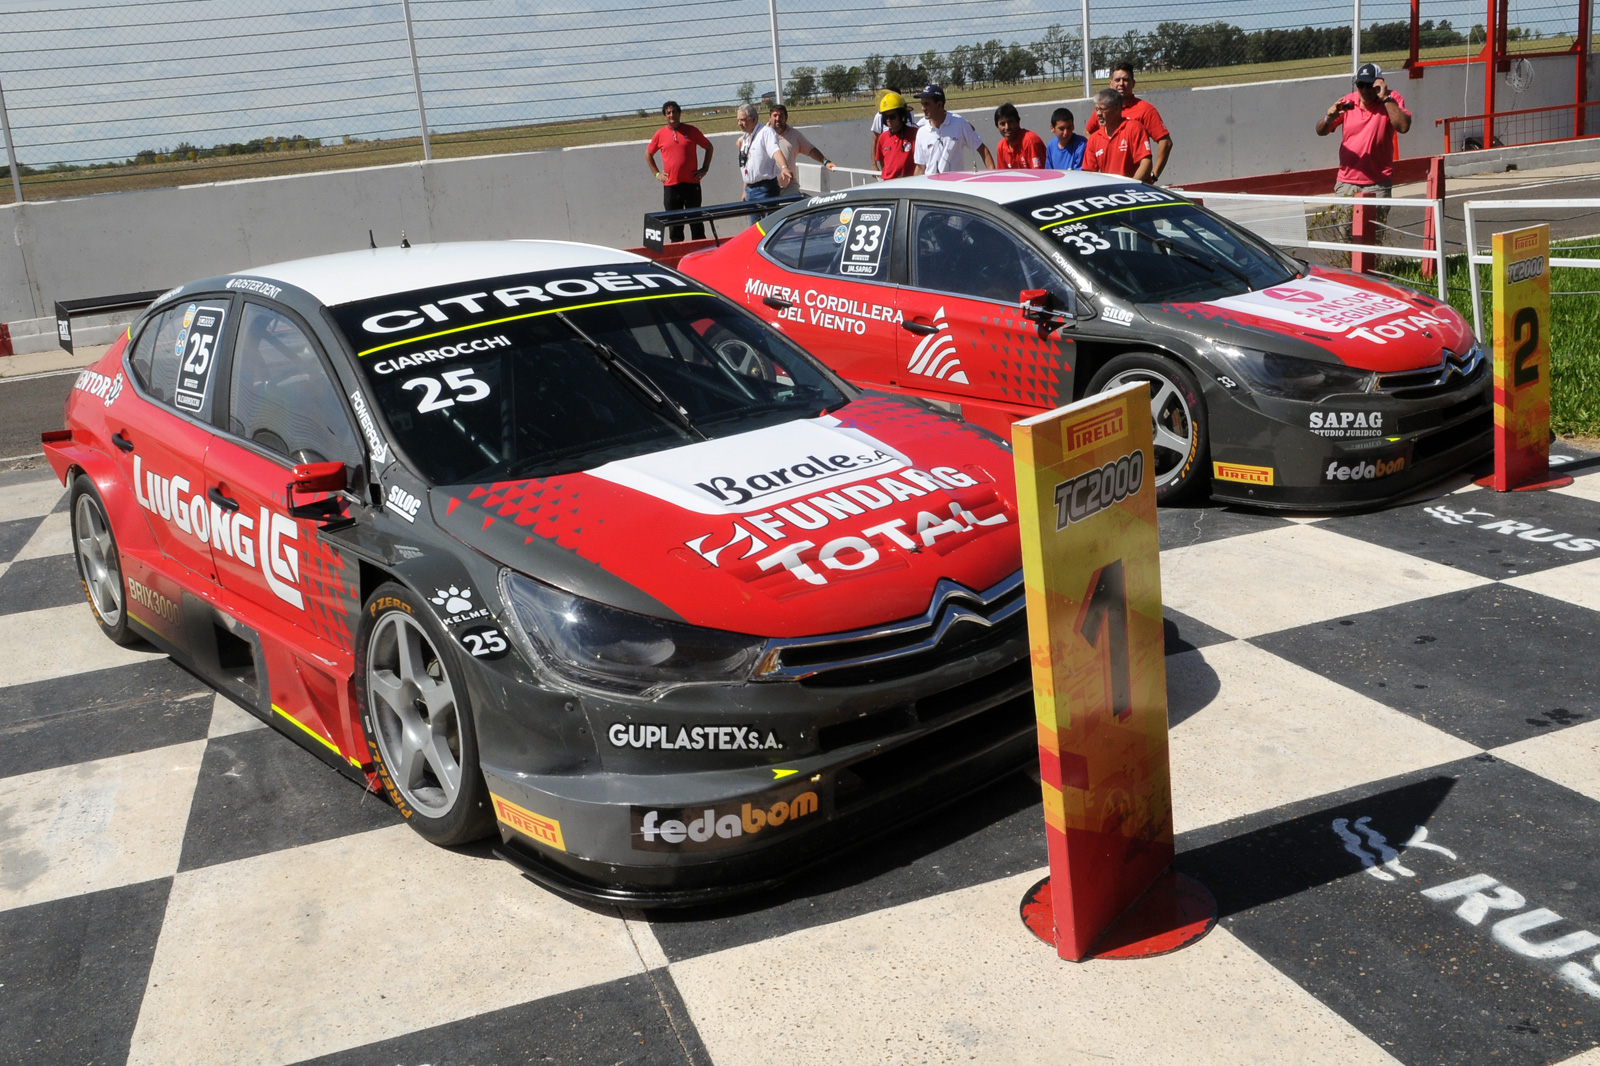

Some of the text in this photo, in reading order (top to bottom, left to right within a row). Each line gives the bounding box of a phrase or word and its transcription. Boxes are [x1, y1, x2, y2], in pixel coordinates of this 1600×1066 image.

[1031, 190, 1174, 221] CITROËN
[850, 224, 881, 252] 33
[1052, 223, 1088, 237] SAPAG
[1063, 231, 1111, 256] 33
[1515, 232, 1538, 249] PIRELLI
[1508, 254, 1544, 285] TC2000
[362, 271, 687, 334] CITROËN
[745, 278, 904, 325] MINERA CORDILLERA
[1103, 306, 1134, 323] SILOC
[1321, 298, 1402, 328] SEGUROS
[777, 307, 866, 335] DEL VIENTO
[1346, 311, 1451, 345] TOTAL
[183, 332, 214, 375] 25
[373, 335, 512, 375] CIARROCCHI
[1512, 306, 1540, 387] 2
[75, 370, 111, 399] ENTOR
[402, 368, 491, 414] 25
[1216, 375, 1237, 389] 33
[351, 390, 385, 458] POWERADE
[1067, 406, 1124, 452] PIRELLI
[1309, 412, 1383, 429] SAPAG
[1346, 430, 1382, 438] JURIDICO
[1182, 421, 1198, 478] PIRELLI
[695, 451, 858, 505] Barale
[1217, 466, 1270, 483] PIRELLI
[1325, 457, 1406, 481] fedabom
[388, 484, 422, 517] SILOC
[743, 466, 979, 541] FUNDARG
[1054, 450, 1144, 532] TC2000
[756, 502, 1008, 585] TOTAL
[1478, 519, 1600, 552] RUS
[128, 577, 180, 626] BRIX3000
[376, 597, 412, 614] ZERO
[443, 608, 490, 625] KELME
[462, 630, 507, 657] 25
[1077, 558, 1132, 719] 1
[608, 723, 750, 750] GUPLASTEX
[368, 740, 413, 819] PIRELLI
[496, 799, 558, 844] PIRELLI
[640, 790, 819, 844] fedabom
